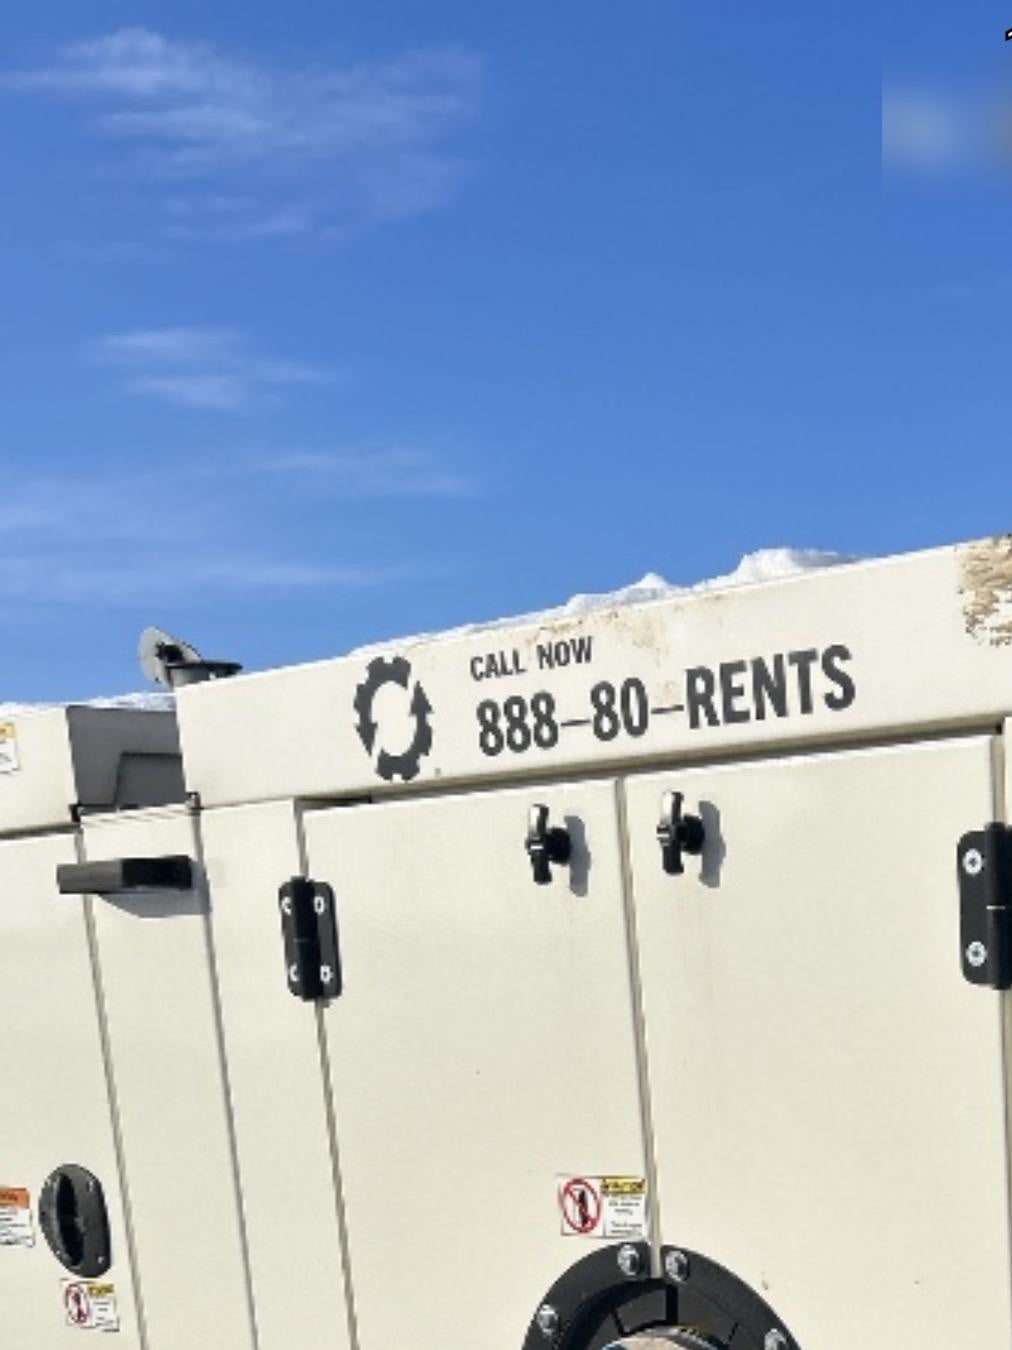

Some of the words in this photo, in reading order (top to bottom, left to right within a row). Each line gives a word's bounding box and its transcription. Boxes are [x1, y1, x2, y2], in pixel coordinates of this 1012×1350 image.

[470, 650, 527, 682] CALL
[537, 636, 594, 671] NOW
[475, 643, 857, 757] 888-80-RENTS
